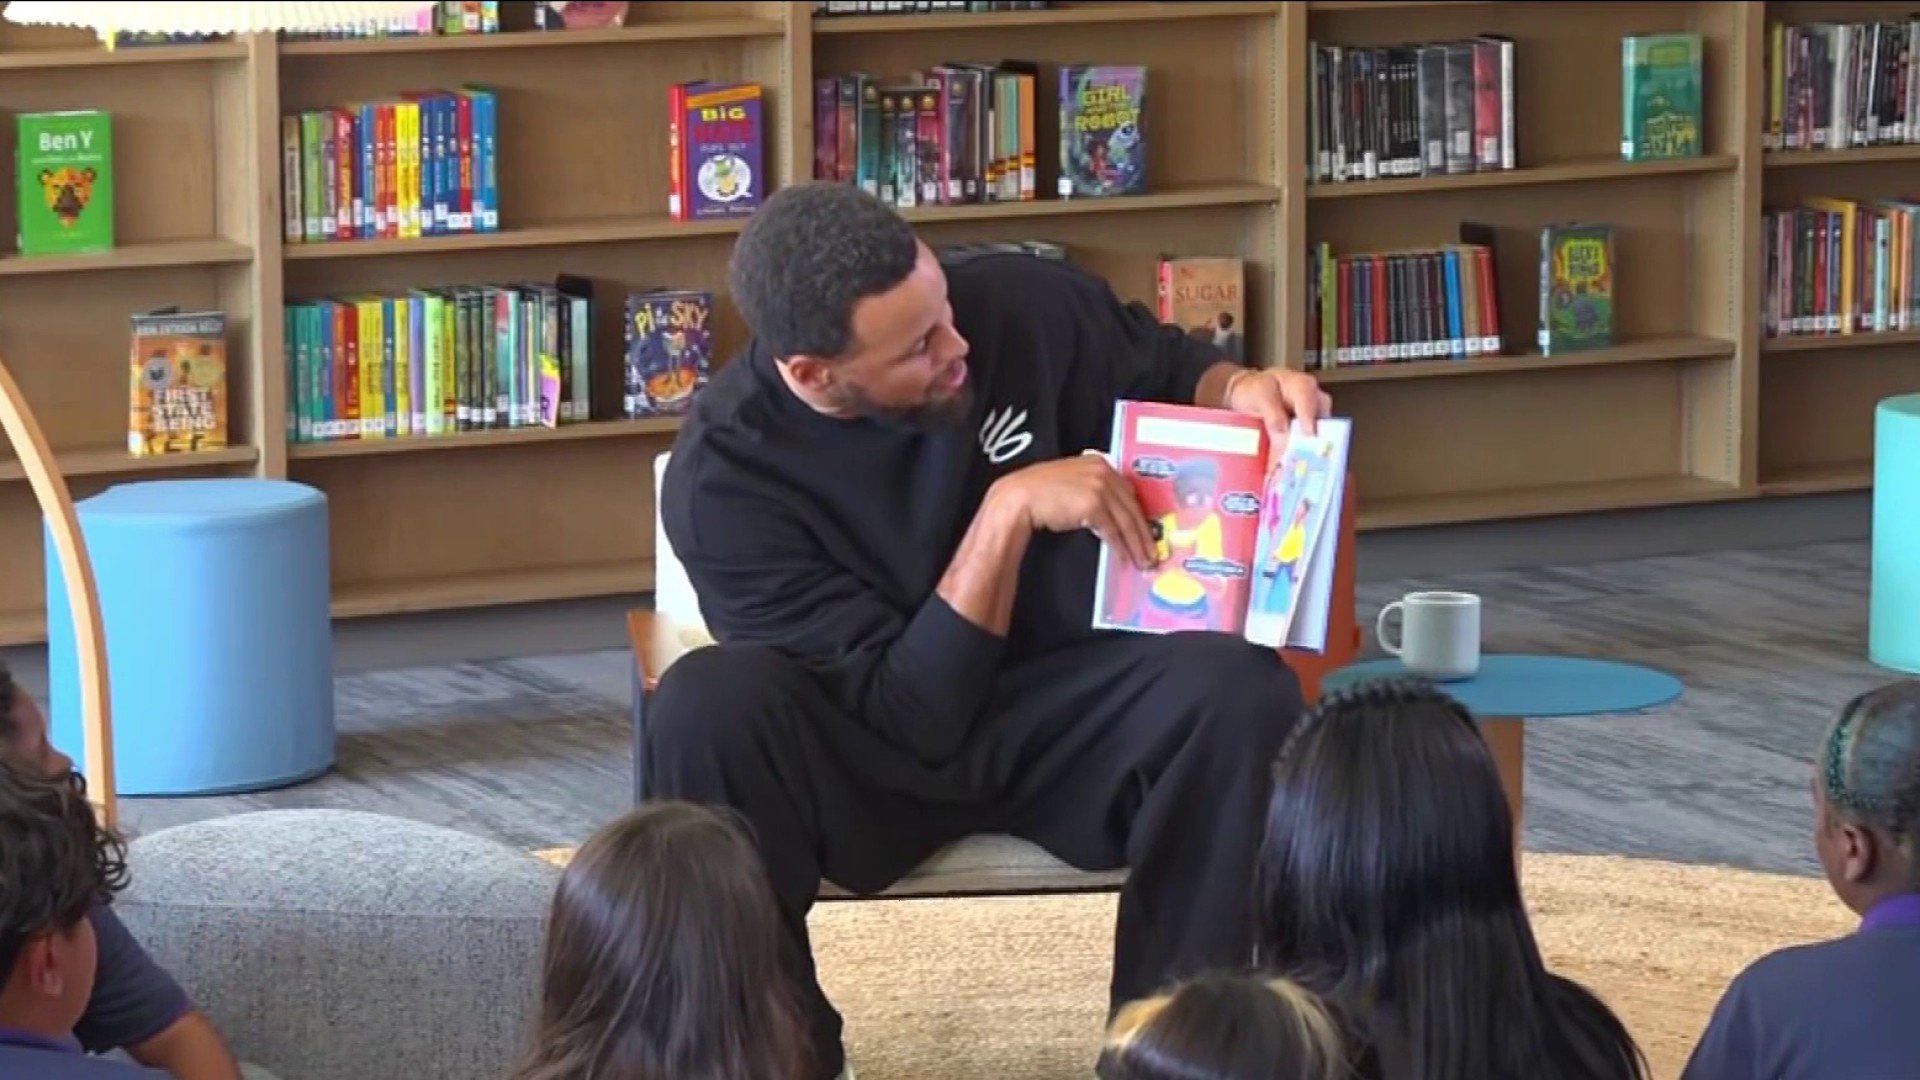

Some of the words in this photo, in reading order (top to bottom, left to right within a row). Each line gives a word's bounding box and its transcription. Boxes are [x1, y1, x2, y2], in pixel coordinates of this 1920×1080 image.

[1083, 85, 1131, 105] GIRL
[1075, 107, 1140, 131] ROBOT
[39, 132, 77, 151] Ben
[79, 130, 94, 148] Y
[1176, 283, 1238, 303] SUGAR
[671, 300, 709, 330] SKY
